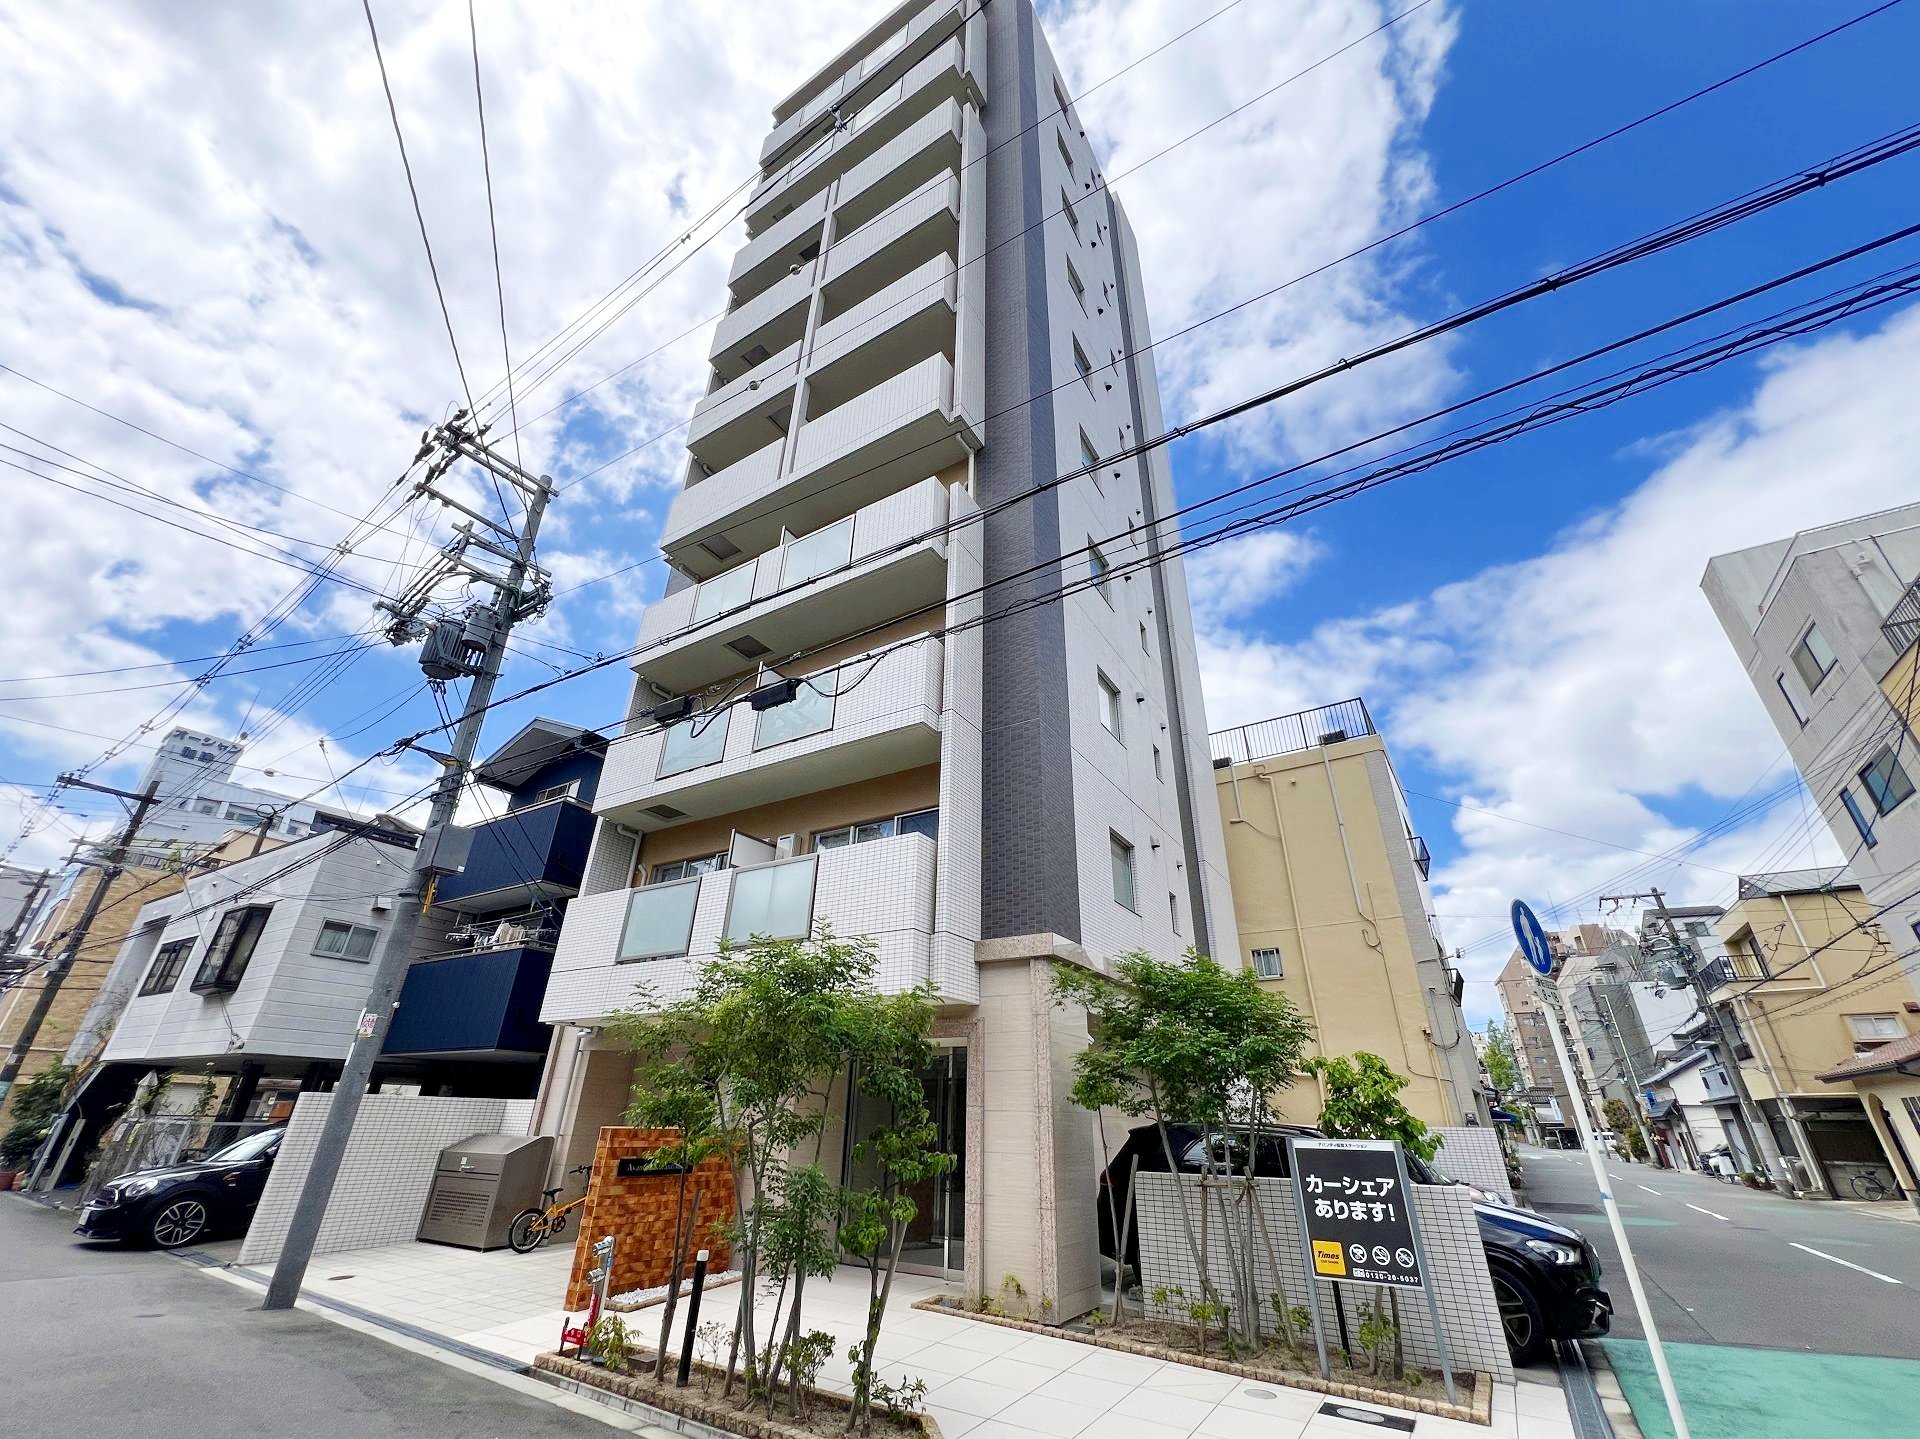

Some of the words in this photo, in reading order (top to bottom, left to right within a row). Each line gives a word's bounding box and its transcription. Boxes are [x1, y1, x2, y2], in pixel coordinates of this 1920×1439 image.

[1305, 1174, 1395, 1197] カーシェア
[1314, 1198, 1396, 1222] あります!
[1317, 1250, 1340, 1260] Times
[1365, 1271, 1419, 1283] 0120-20-5037
